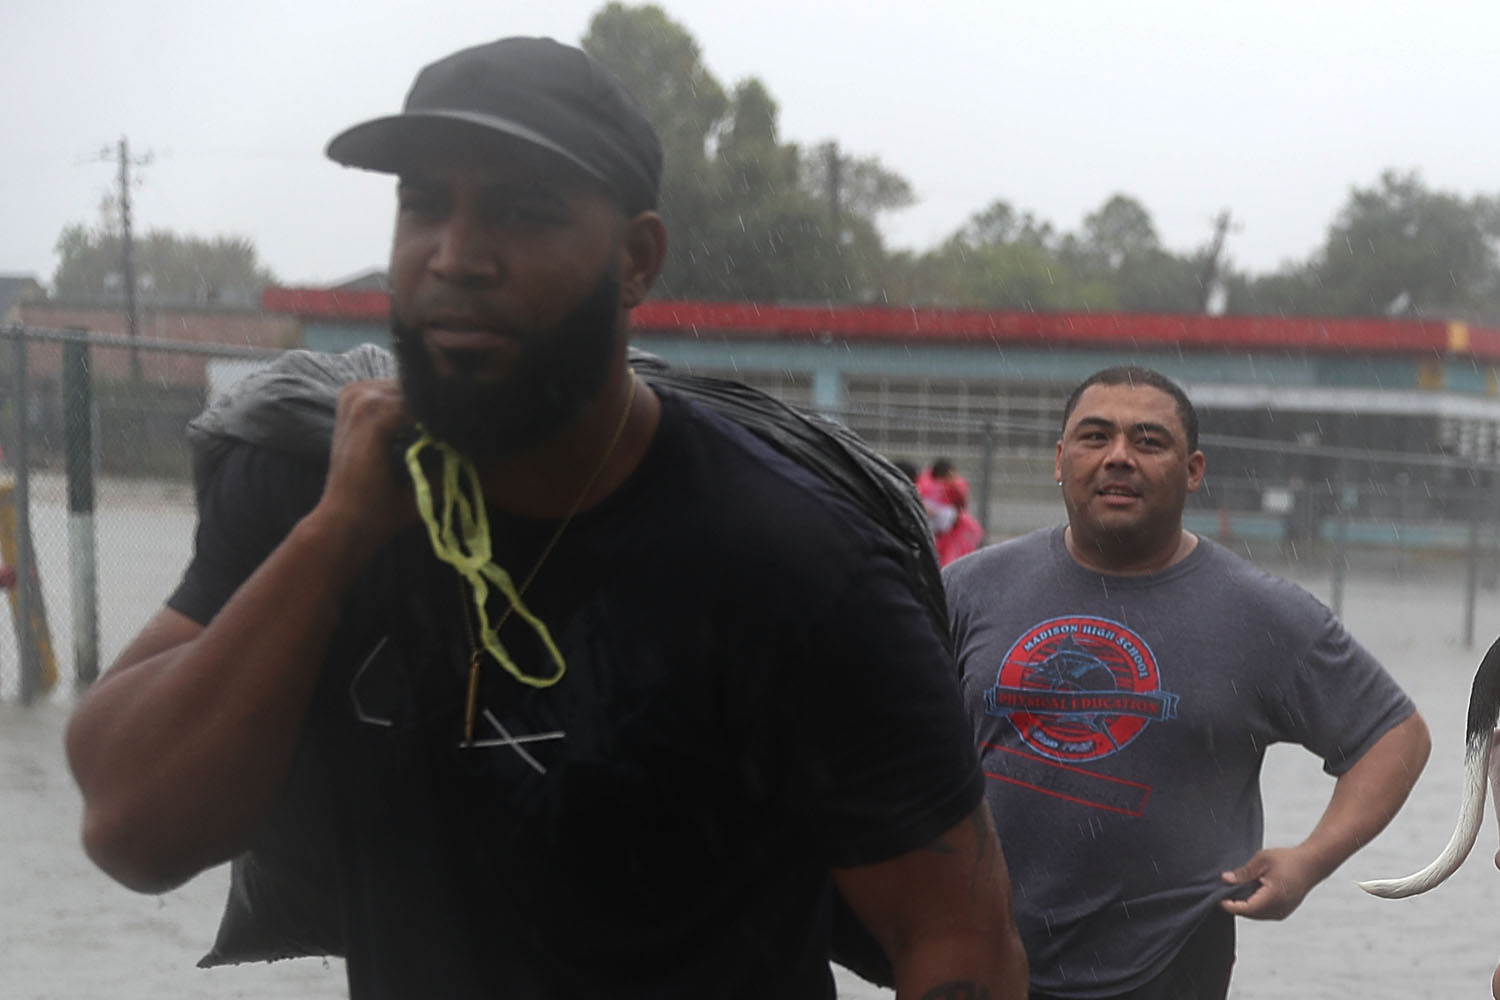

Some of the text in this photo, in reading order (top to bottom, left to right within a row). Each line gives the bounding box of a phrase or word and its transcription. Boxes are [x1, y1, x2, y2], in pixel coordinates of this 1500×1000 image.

[1024, 624, 1149, 679] MADISON HIGH SCHOOL
[999, 691, 1159, 713] PHYSICAL EDUCATION
